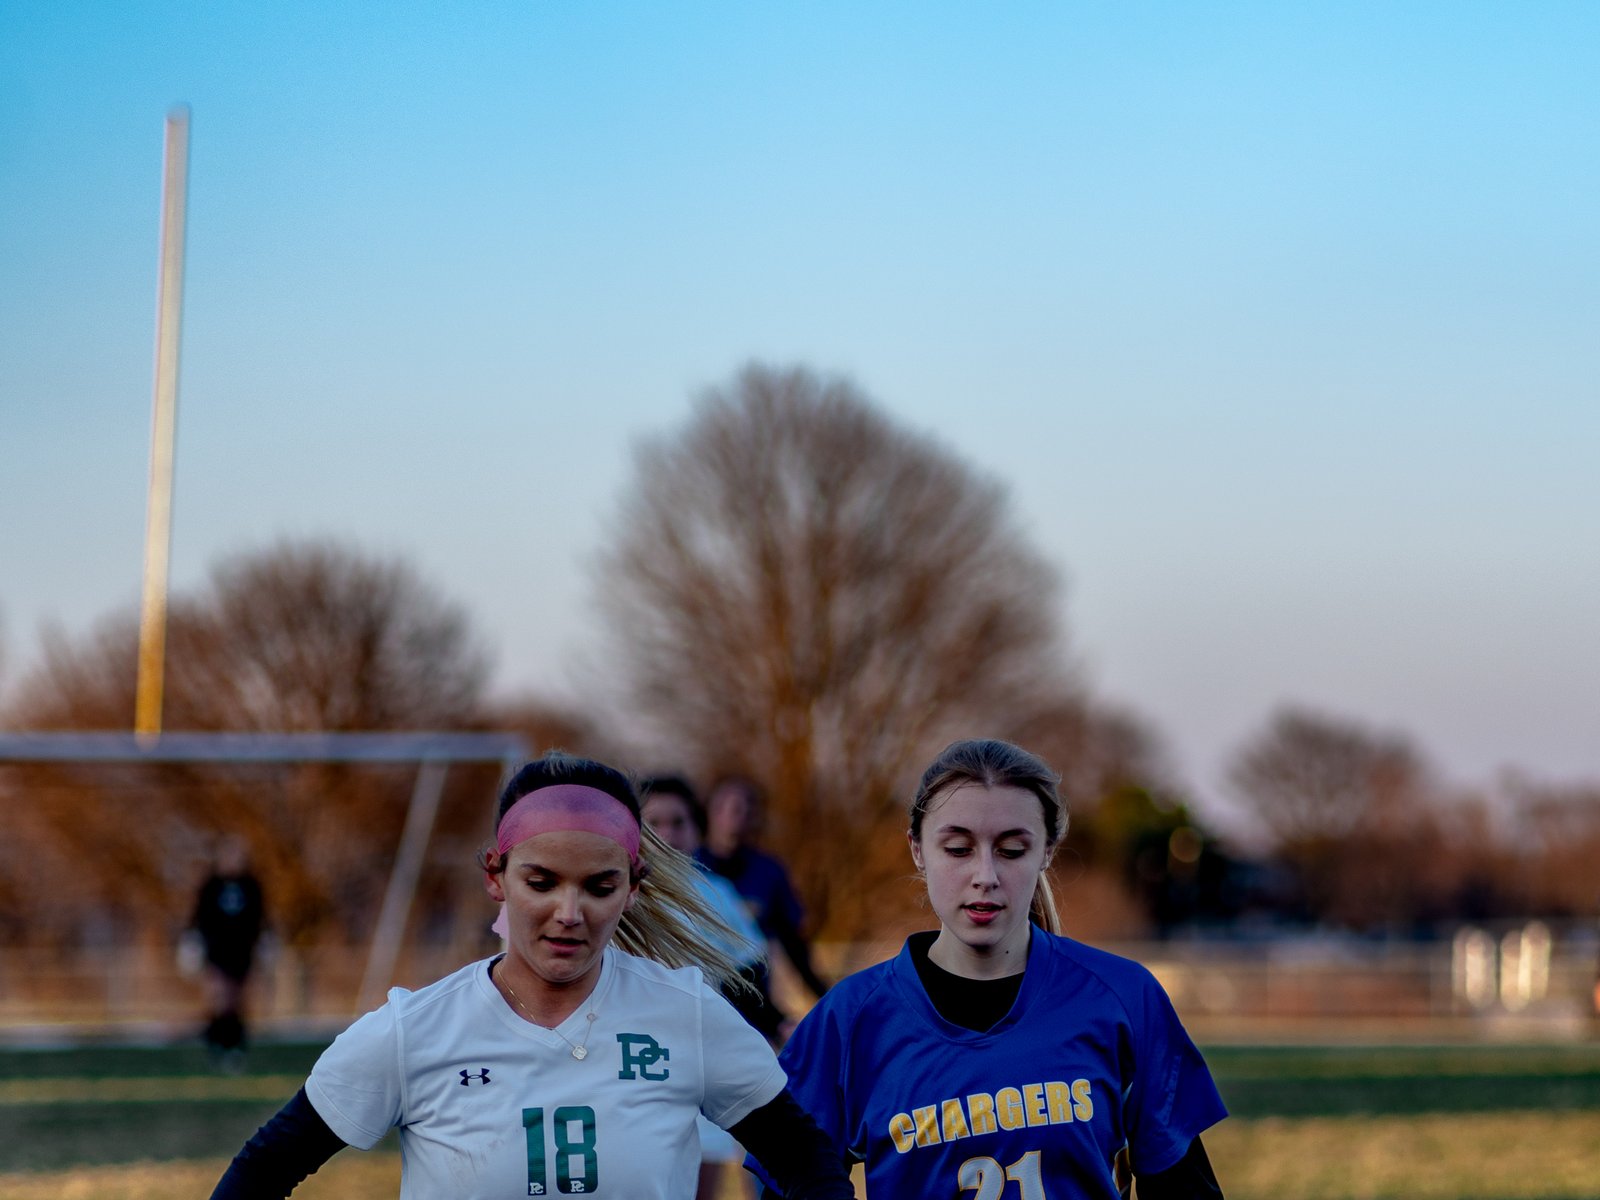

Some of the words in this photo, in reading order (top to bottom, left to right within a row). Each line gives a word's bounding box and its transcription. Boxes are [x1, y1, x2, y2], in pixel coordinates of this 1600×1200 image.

[616, 1033, 669, 1081] PC
[522, 1105, 599, 1196] 18
[888, 1078, 1094, 1154] CHARGERS
